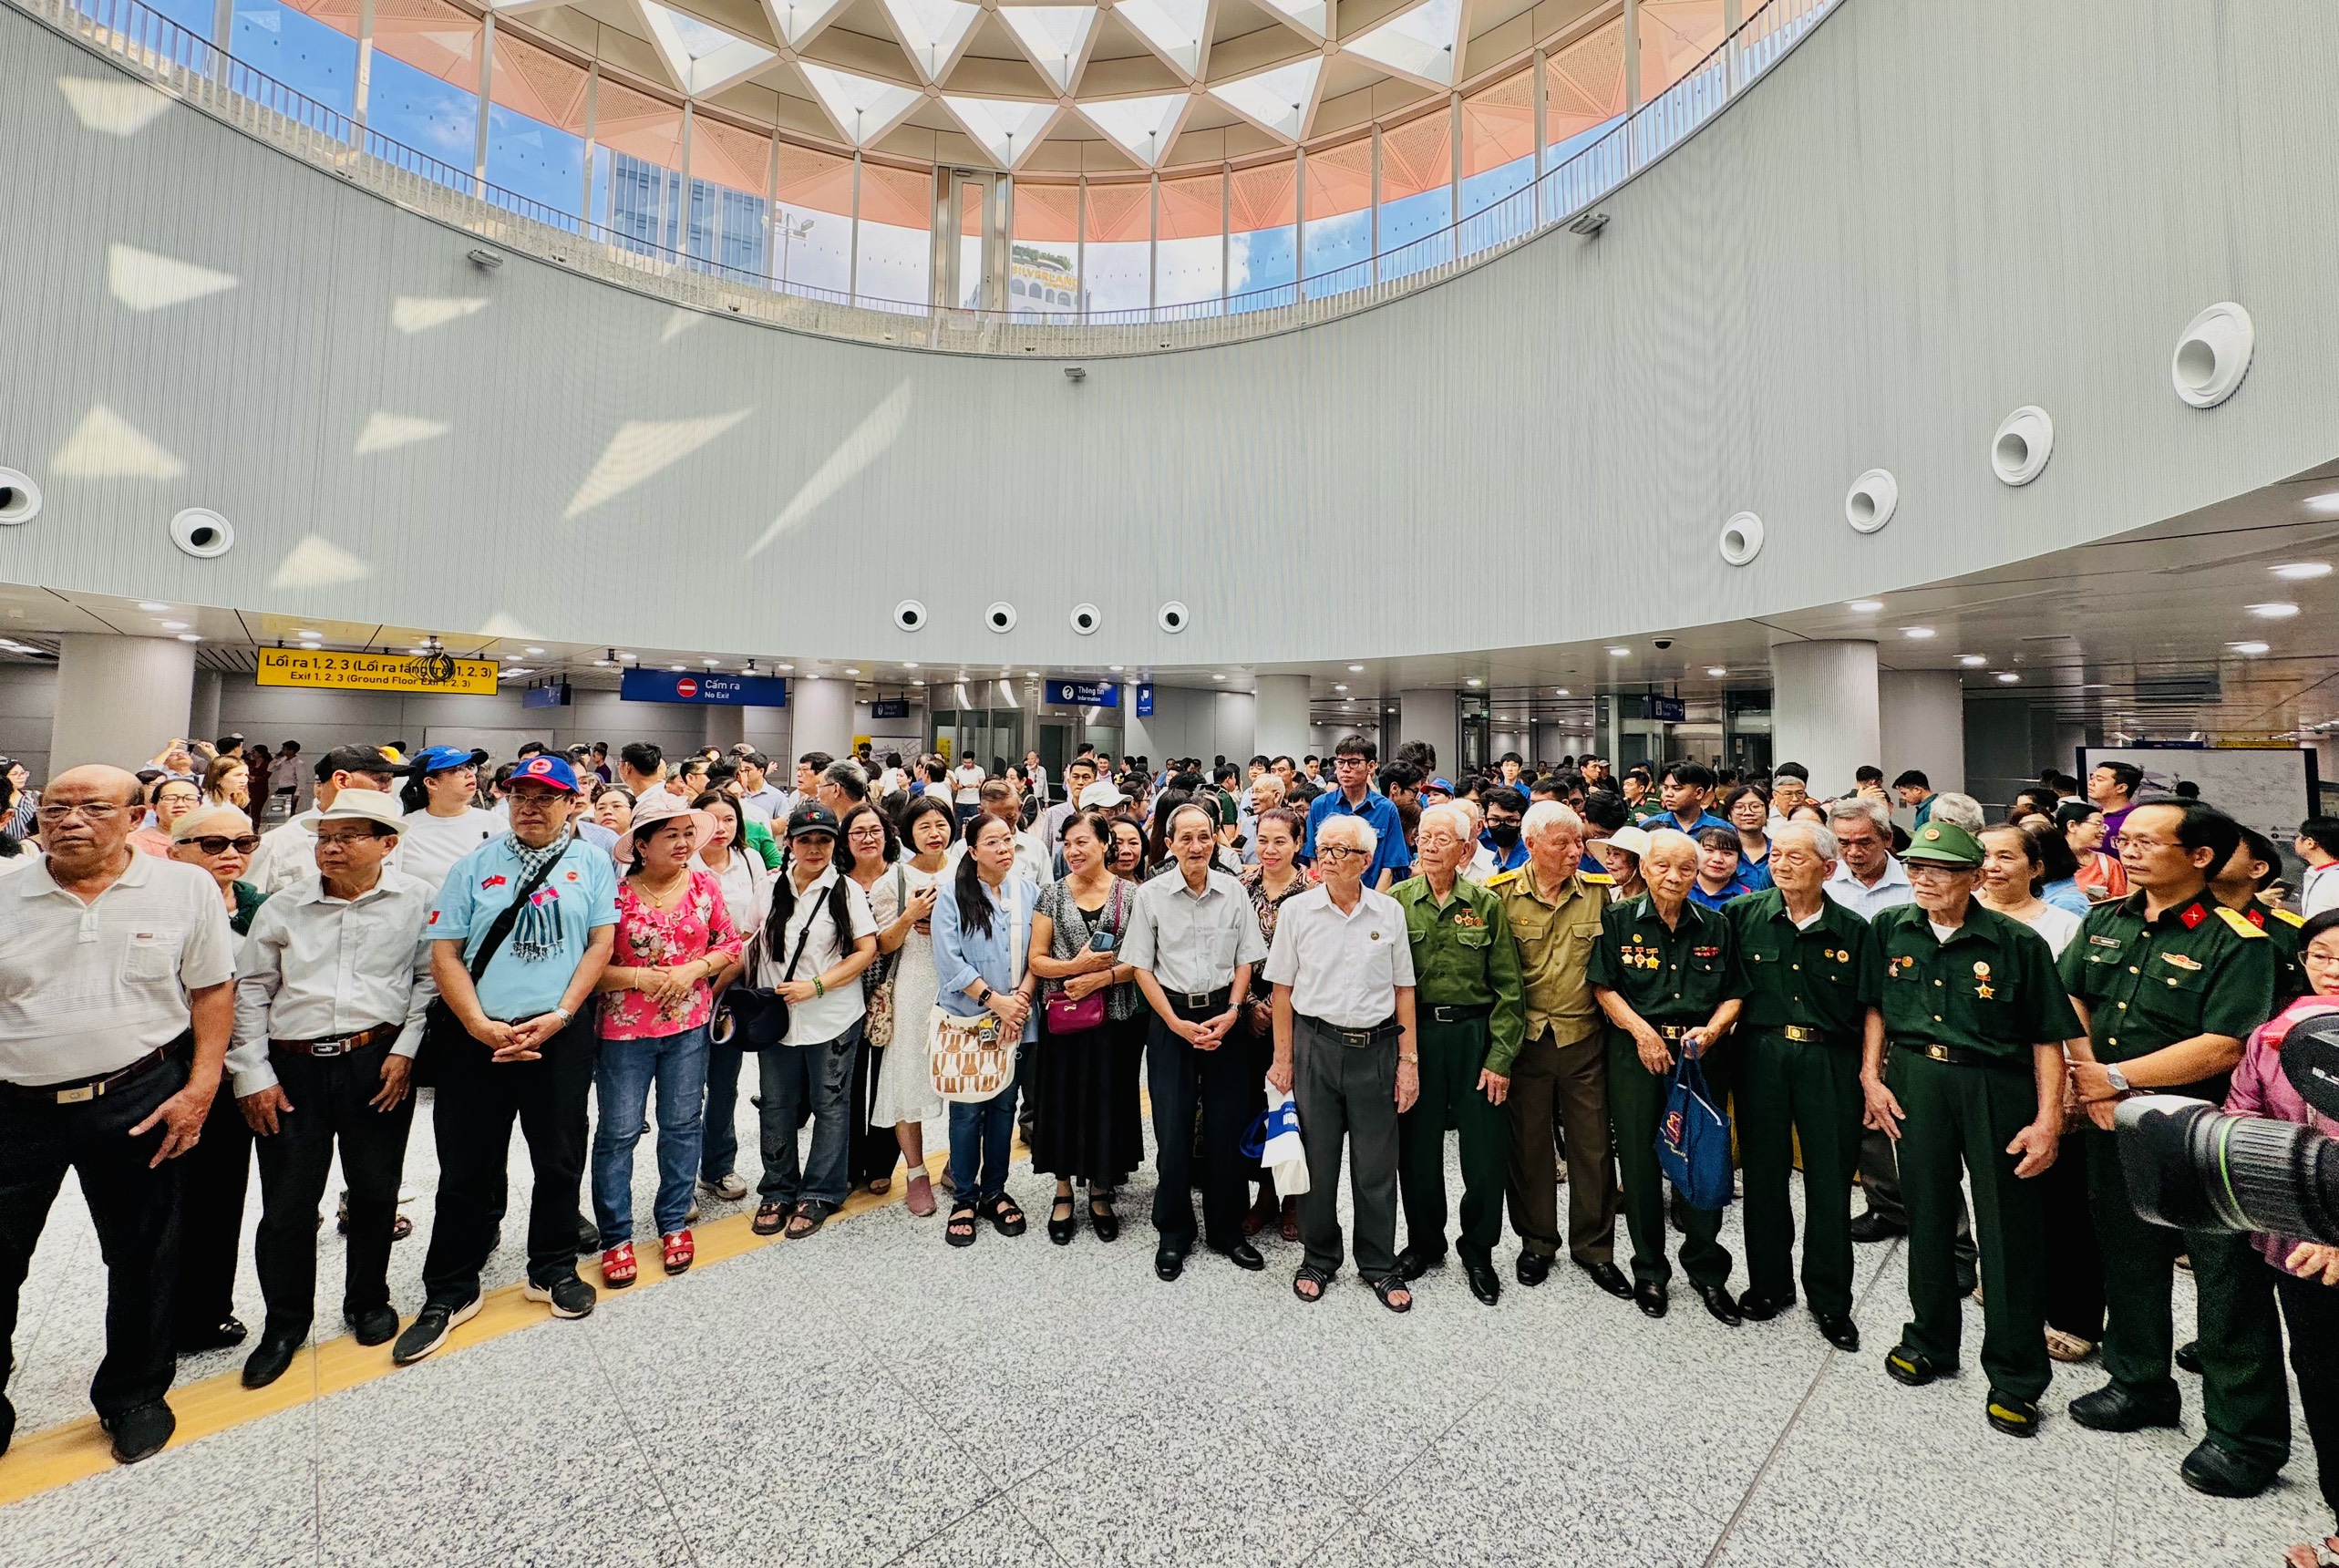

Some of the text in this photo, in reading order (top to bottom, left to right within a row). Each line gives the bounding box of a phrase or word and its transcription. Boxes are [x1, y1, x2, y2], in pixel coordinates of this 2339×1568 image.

[265, 655, 289, 667] Lối
[293, 659, 308, 668] ra
[313, 657, 321, 669] 1,
[325, 658, 337, 670] 2,
[341, 659, 350, 669] 3
[353, 660, 379, 672] (Lối
[383, 664, 397, 673] ra
[468, 666, 478, 677] 2,
[480, 667, 492, 678] 3)
[336, 674, 344, 682] 3
[346, 674, 389, 684] (Ground
[392, 676, 417, 685] Floor
[705, 679, 727, 689] Cấm
[705, 691, 715, 699] No
[1077, 686, 1096, 696] Thông
